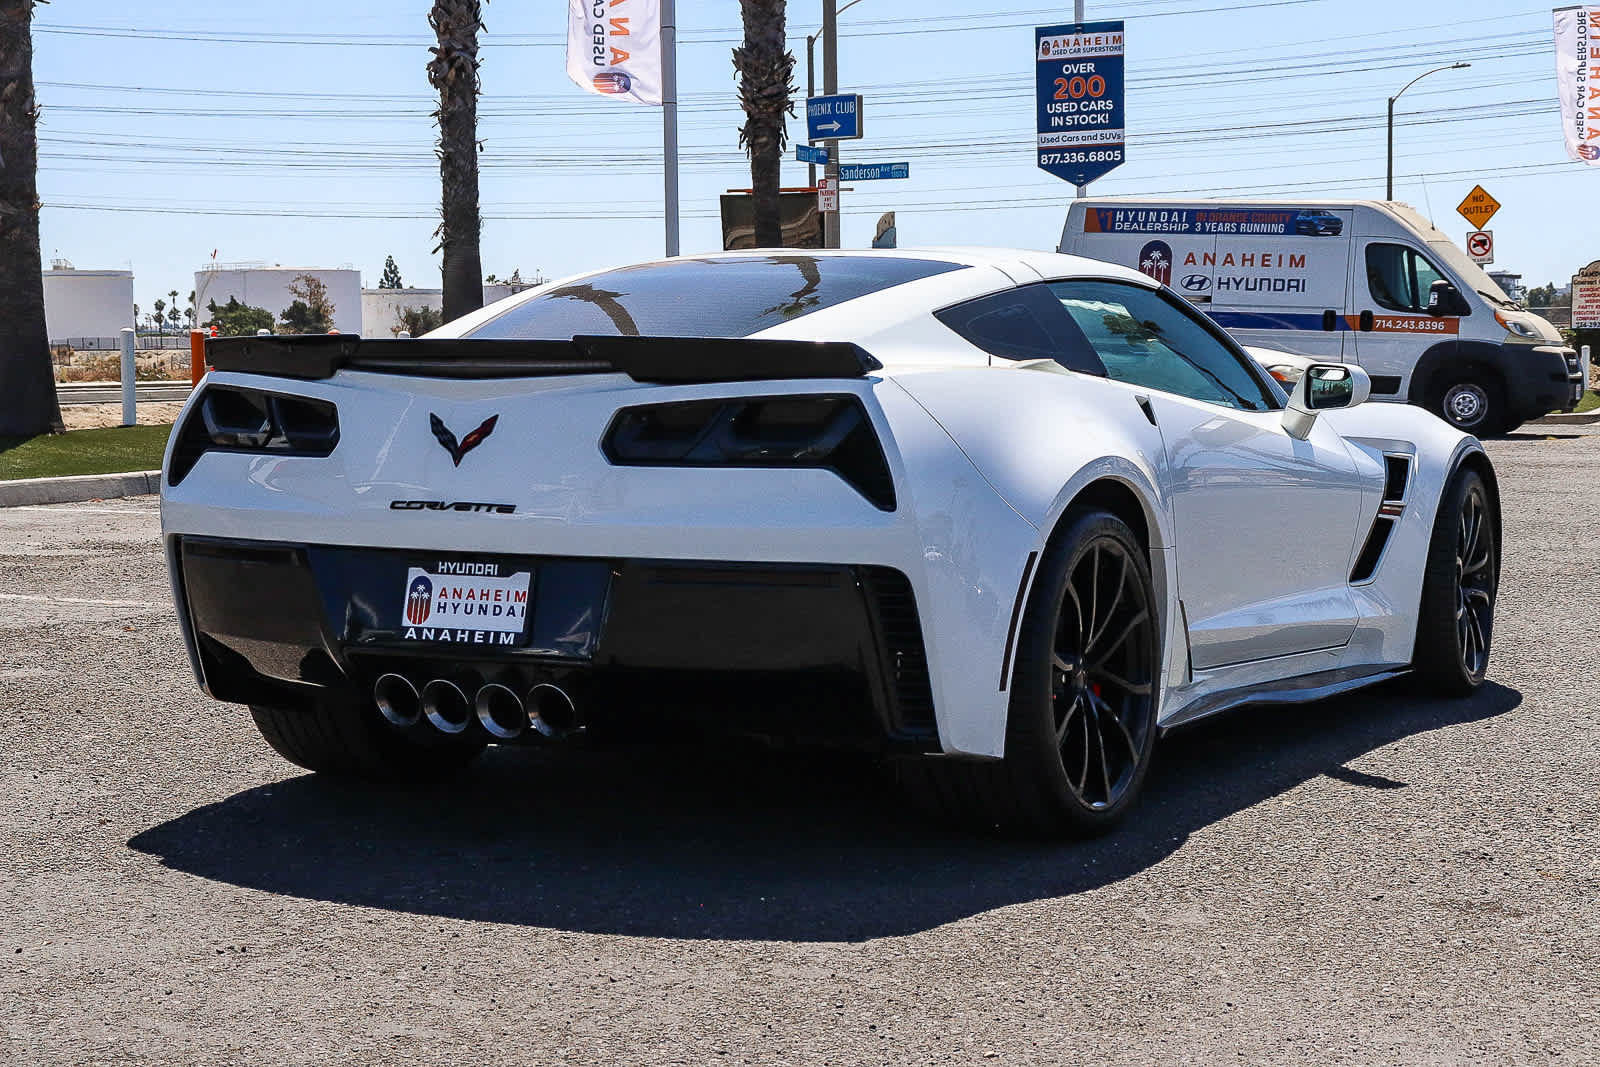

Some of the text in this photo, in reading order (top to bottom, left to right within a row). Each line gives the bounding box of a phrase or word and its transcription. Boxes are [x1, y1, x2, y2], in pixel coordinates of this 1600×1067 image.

[1052, 35, 1122, 48] ANAHEIM
[1052, 45, 1122, 56] USED CAR SUPERSTORE
[1062, 63, 1096, 74] OVER
[1054, 75, 1106, 100] 200
[808, 101, 855, 116] PHOENIX CLUB
[1047, 100, 1113, 113] USED CARS
[1051, 113, 1109, 127] IN STOCK!
[1040, 135, 1060, 144] Used
[1081, 133, 1098, 141] and
[1099, 132, 1121, 140] SUVs
[1040, 150, 1121, 165] 877.336.6805
[840, 166, 880, 180] Sanderson
[1472, 194, 1485, 202] NO
[1115, 211, 1187, 222] HYUNDAI
[1463, 204, 1494, 215] OUTLET
[1115, 222, 1285, 234] DEALERSHIP 3 YEARS RUNNING
[1184, 252, 1306, 268] ANAHEIM
[1217, 277, 1306, 293] HYUNDAI
[1375, 319, 1445, 331] 714.243.8396
[390, 500, 517, 514] CORVETTE
[438, 561, 498, 576] HYUNDAI
[438, 587, 527, 603] ANAHEIM
[437, 602, 525, 617] HYUNDAI
[404, 627, 515, 645] ANAHEIM
